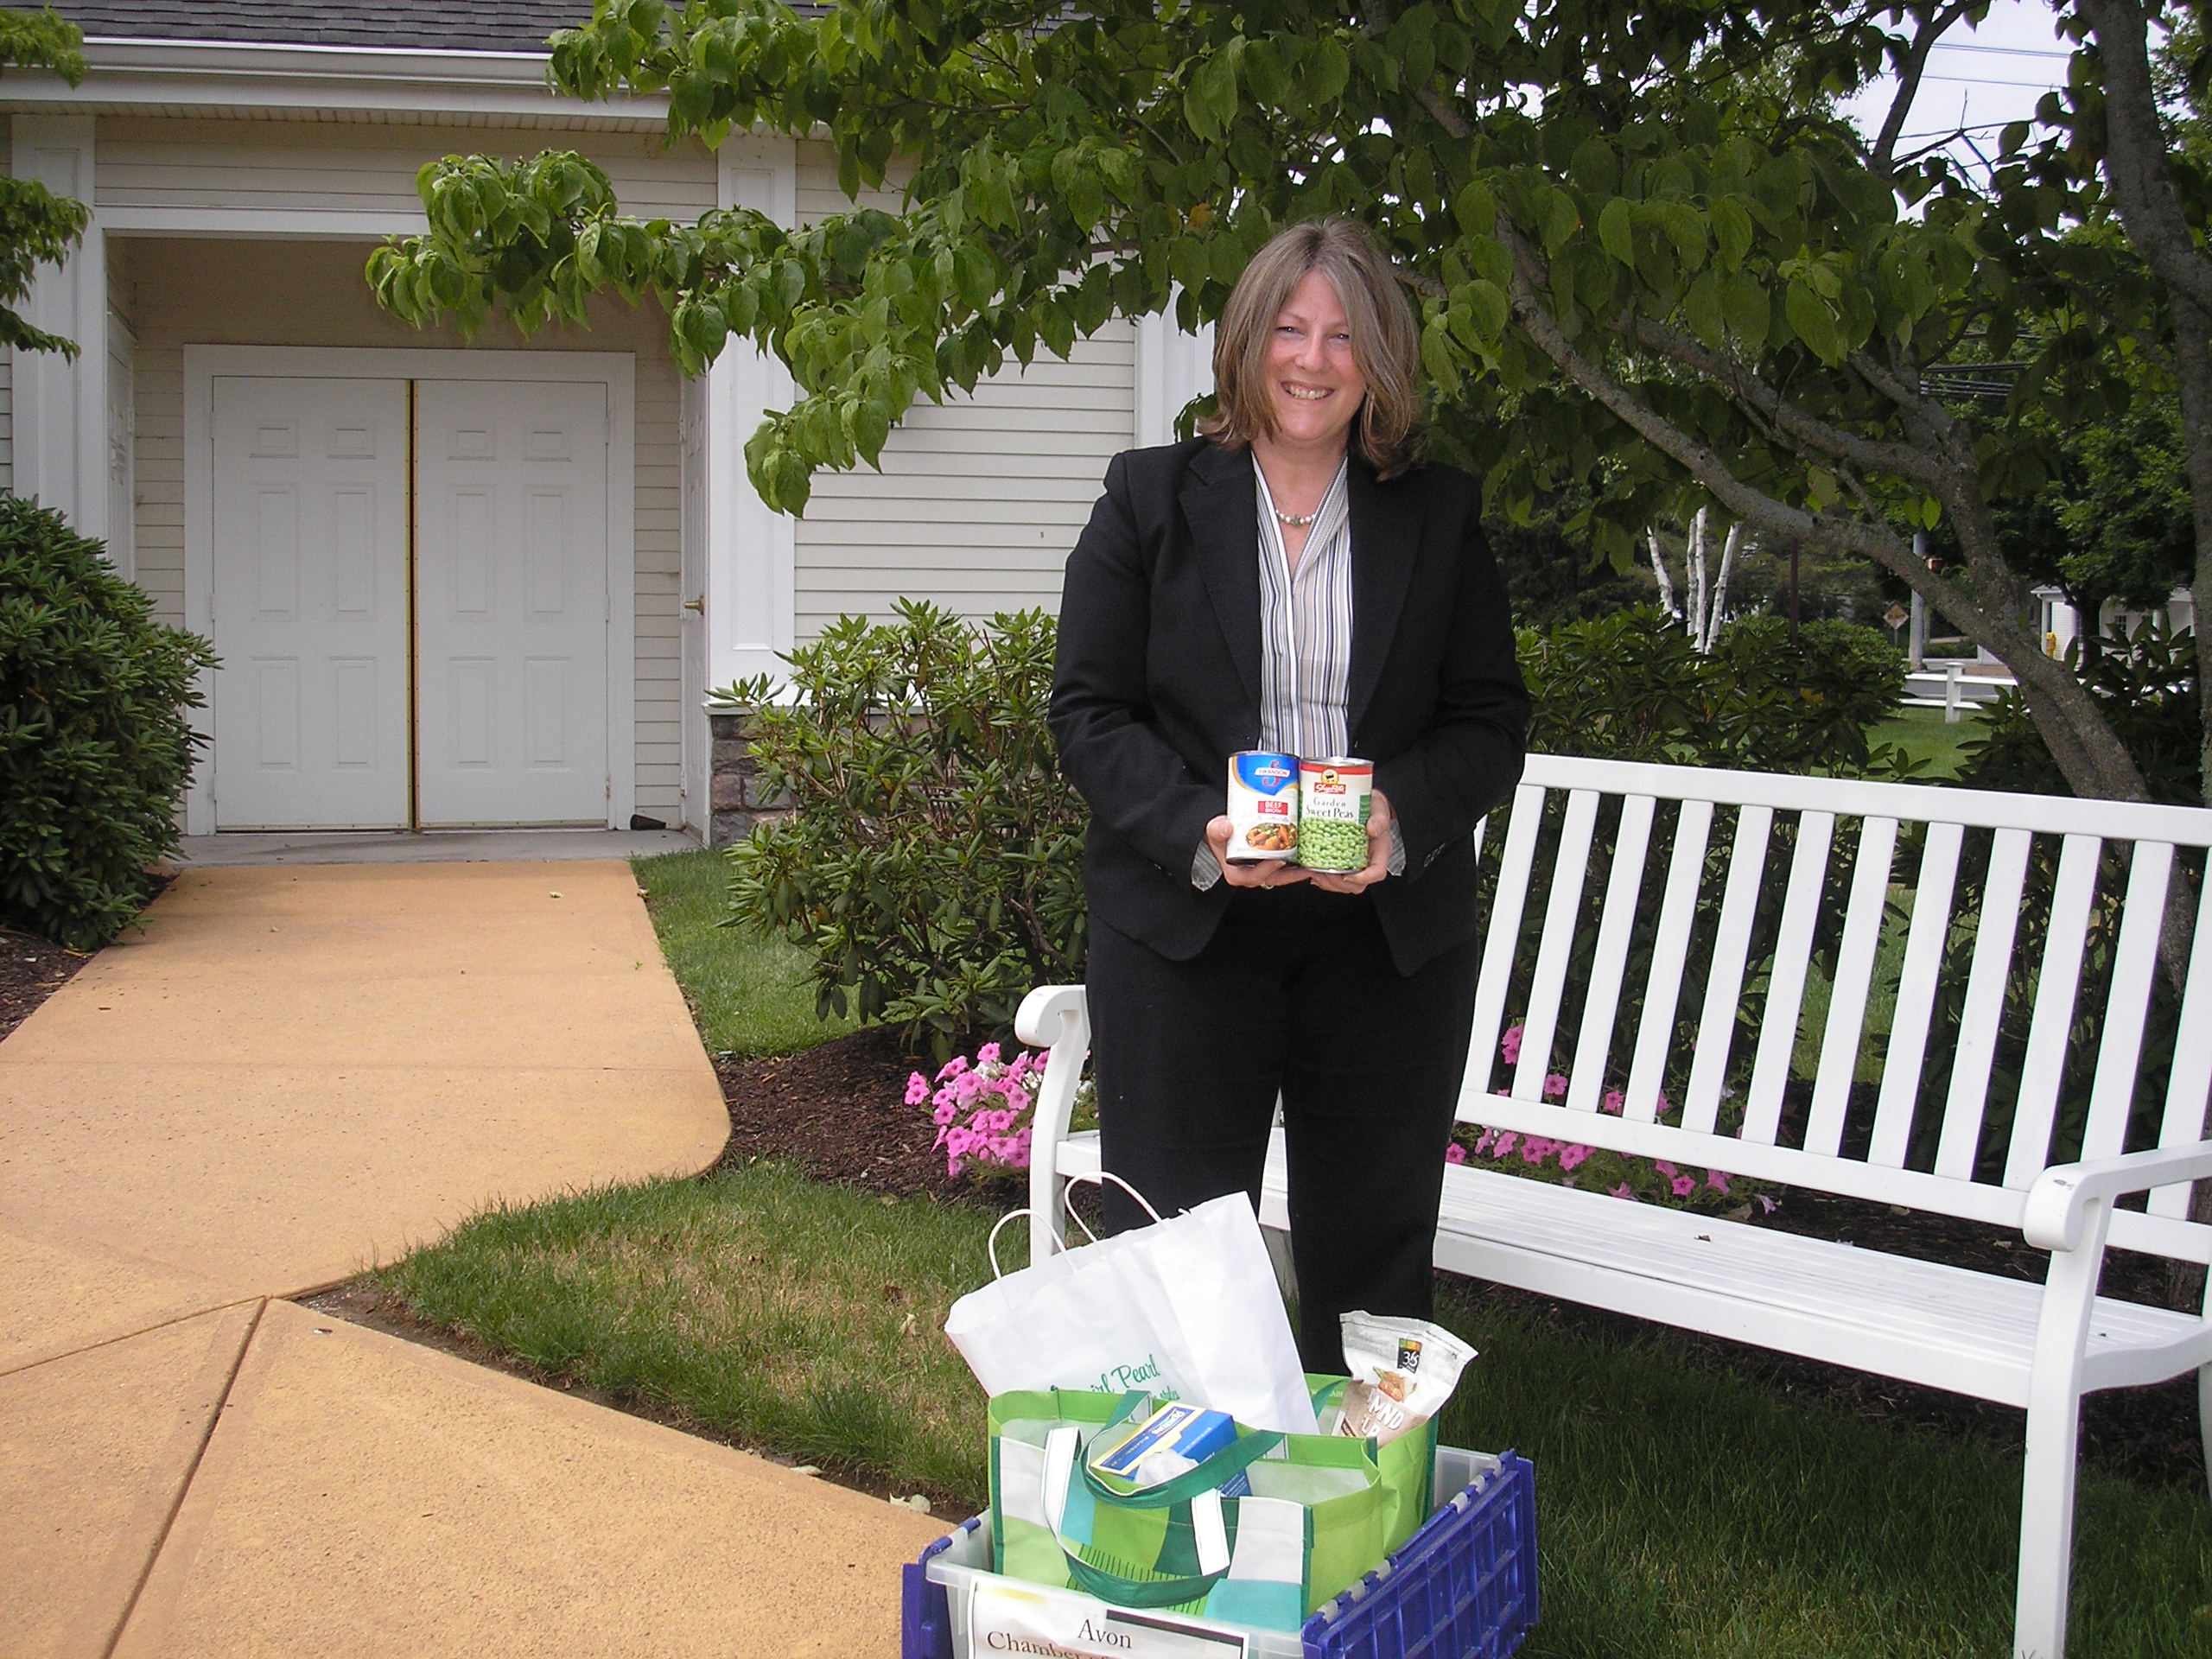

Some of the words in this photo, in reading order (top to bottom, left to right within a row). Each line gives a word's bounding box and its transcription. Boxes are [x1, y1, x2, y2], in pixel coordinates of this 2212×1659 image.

[1306, 804, 1331, 818] Sweet
[1333, 808, 1355, 819] Peas
[1313, 797, 1346, 807] Garden
[1110, 1354, 1160, 1388] Pearl
[987, 1631, 1080, 1659] Chamber
[1077, 1619, 1133, 1649] Avon
